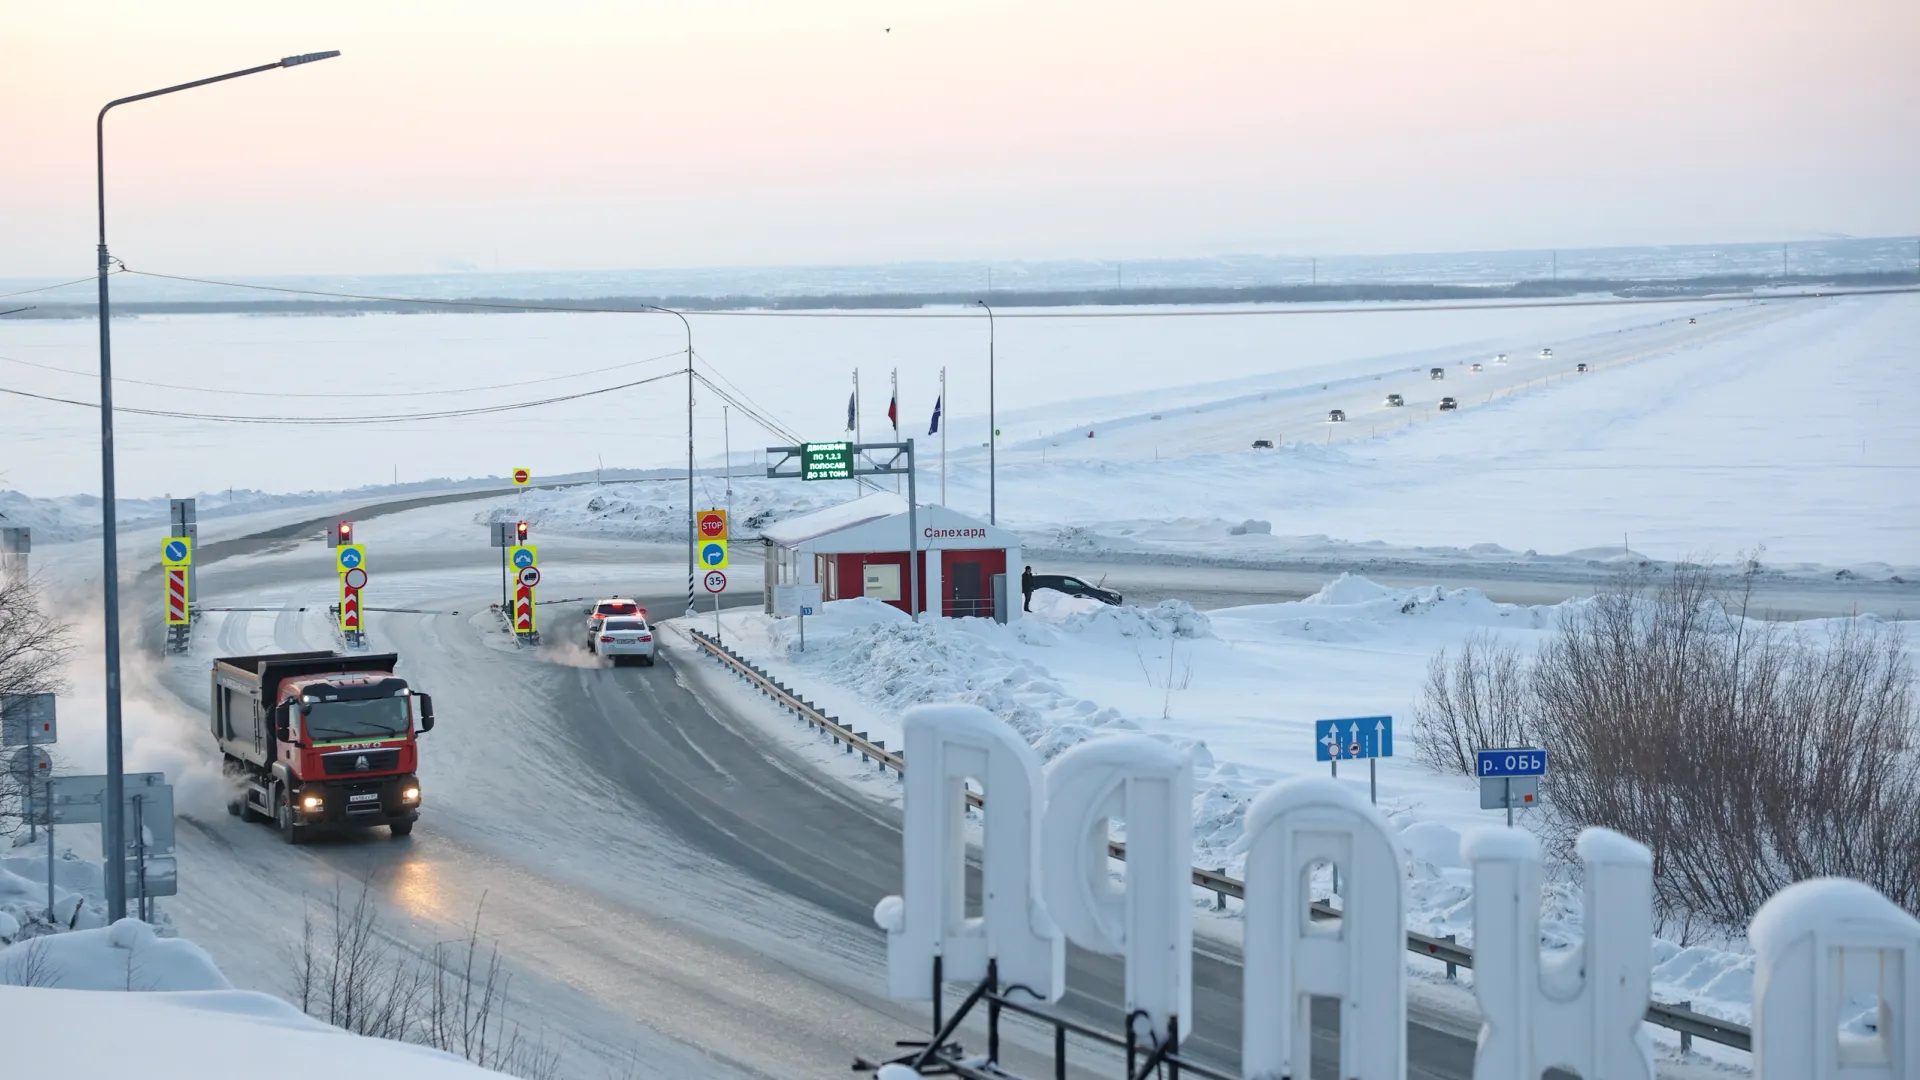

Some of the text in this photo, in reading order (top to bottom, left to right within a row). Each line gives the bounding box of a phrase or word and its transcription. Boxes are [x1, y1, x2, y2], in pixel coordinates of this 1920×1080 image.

[807, 444, 846, 452] ДВИЖЕНИЕ
[807, 471, 818, 479] ДО
[702, 521, 723, 530] STOP
[924, 527, 986, 538] Салехард
[340, 742, 381, 750] HOWO
[1483, 755, 1541, 774] р. ОБЬ
